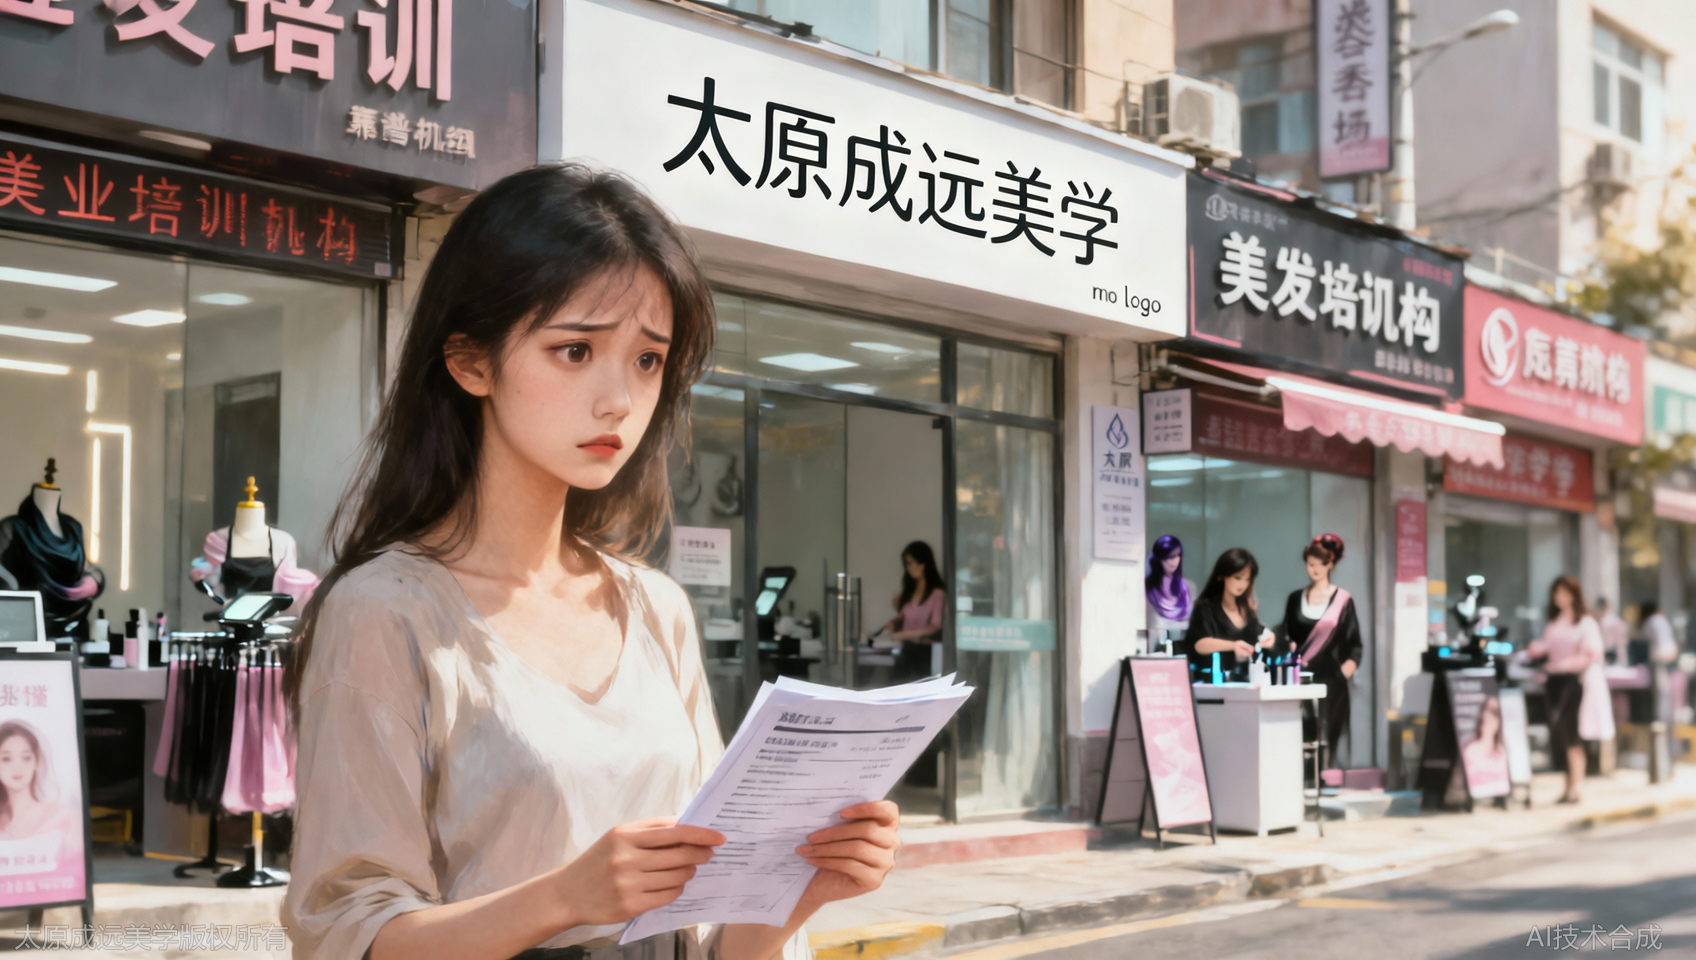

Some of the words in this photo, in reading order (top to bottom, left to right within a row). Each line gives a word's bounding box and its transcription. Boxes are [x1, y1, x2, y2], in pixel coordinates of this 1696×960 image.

[662, 76, 1120, 266] 太原成远美学
[1092, 286, 1117, 304] mo
[1124, 285, 1162, 317] logo
